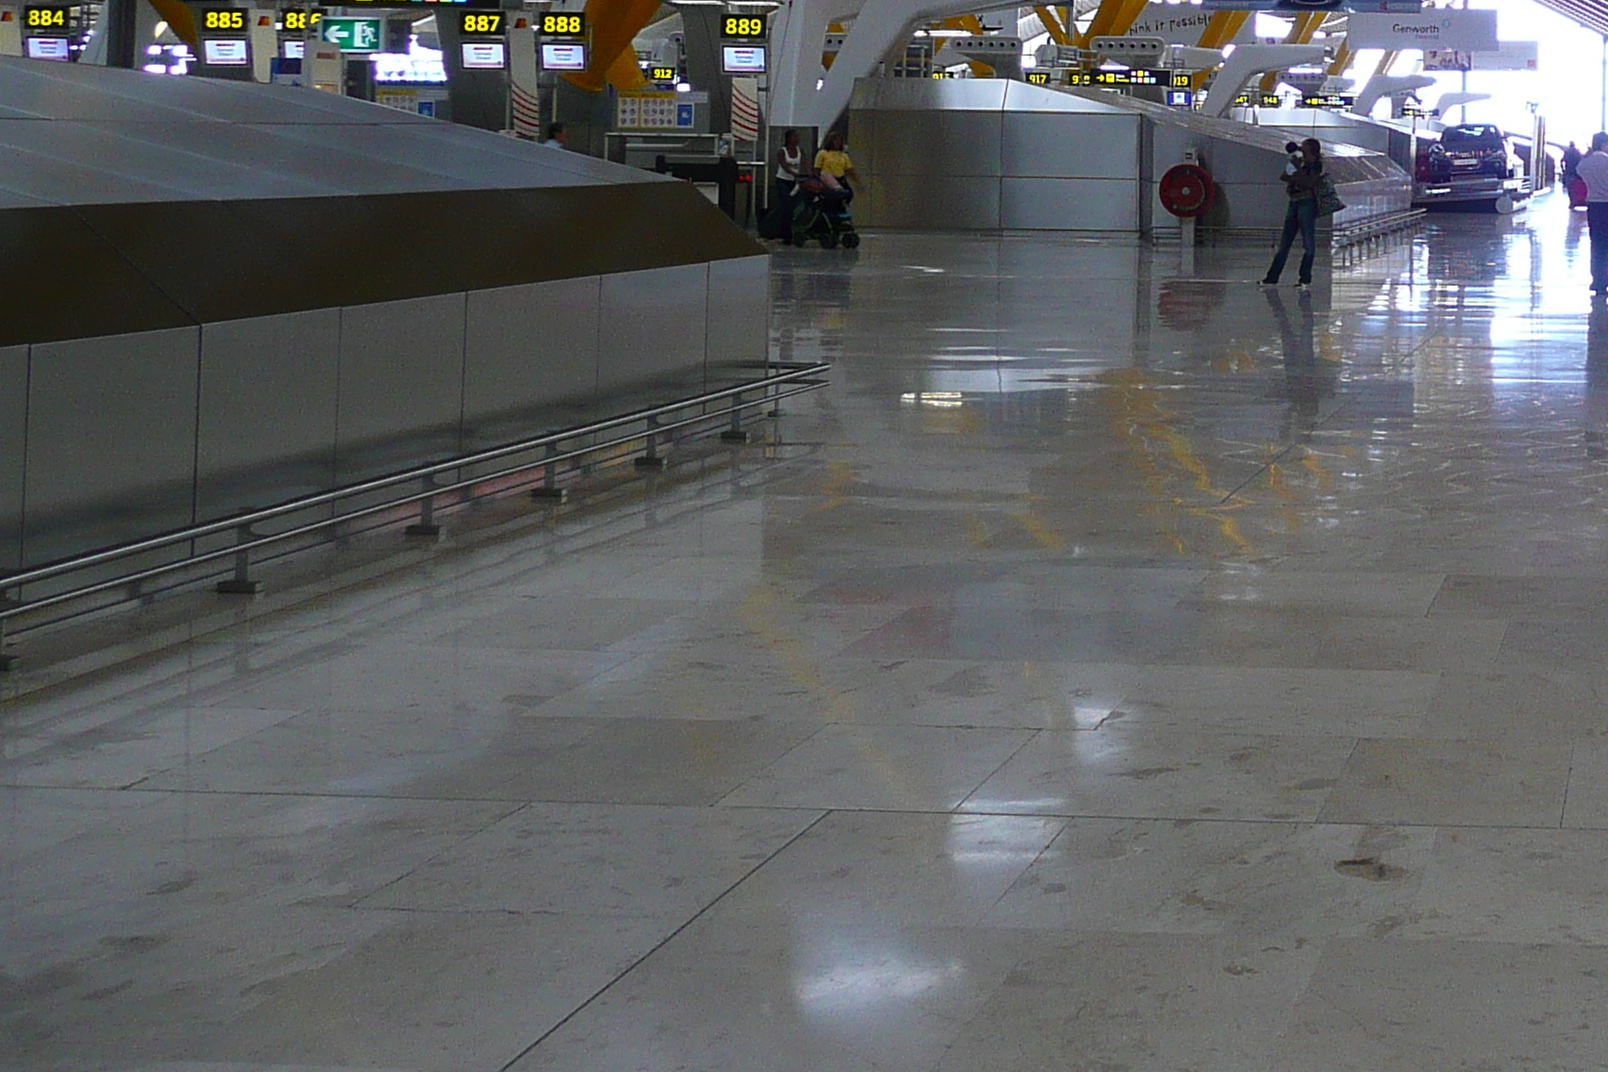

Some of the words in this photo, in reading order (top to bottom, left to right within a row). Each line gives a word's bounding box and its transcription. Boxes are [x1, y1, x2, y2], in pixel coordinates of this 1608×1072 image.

[28, 9, 65, 26] 884
[206, 11, 243, 28] 885
[464, 15, 501, 32] 887
[543, 16, 581, 33] 888
[725, 18, 762, 35] 889
[1392, 23, 1440, 34] Genworth
[653, 68, 673, 79] 912
[1029, 75, 1047, 84] 917
[1071, 75, 1090, 85] 98
